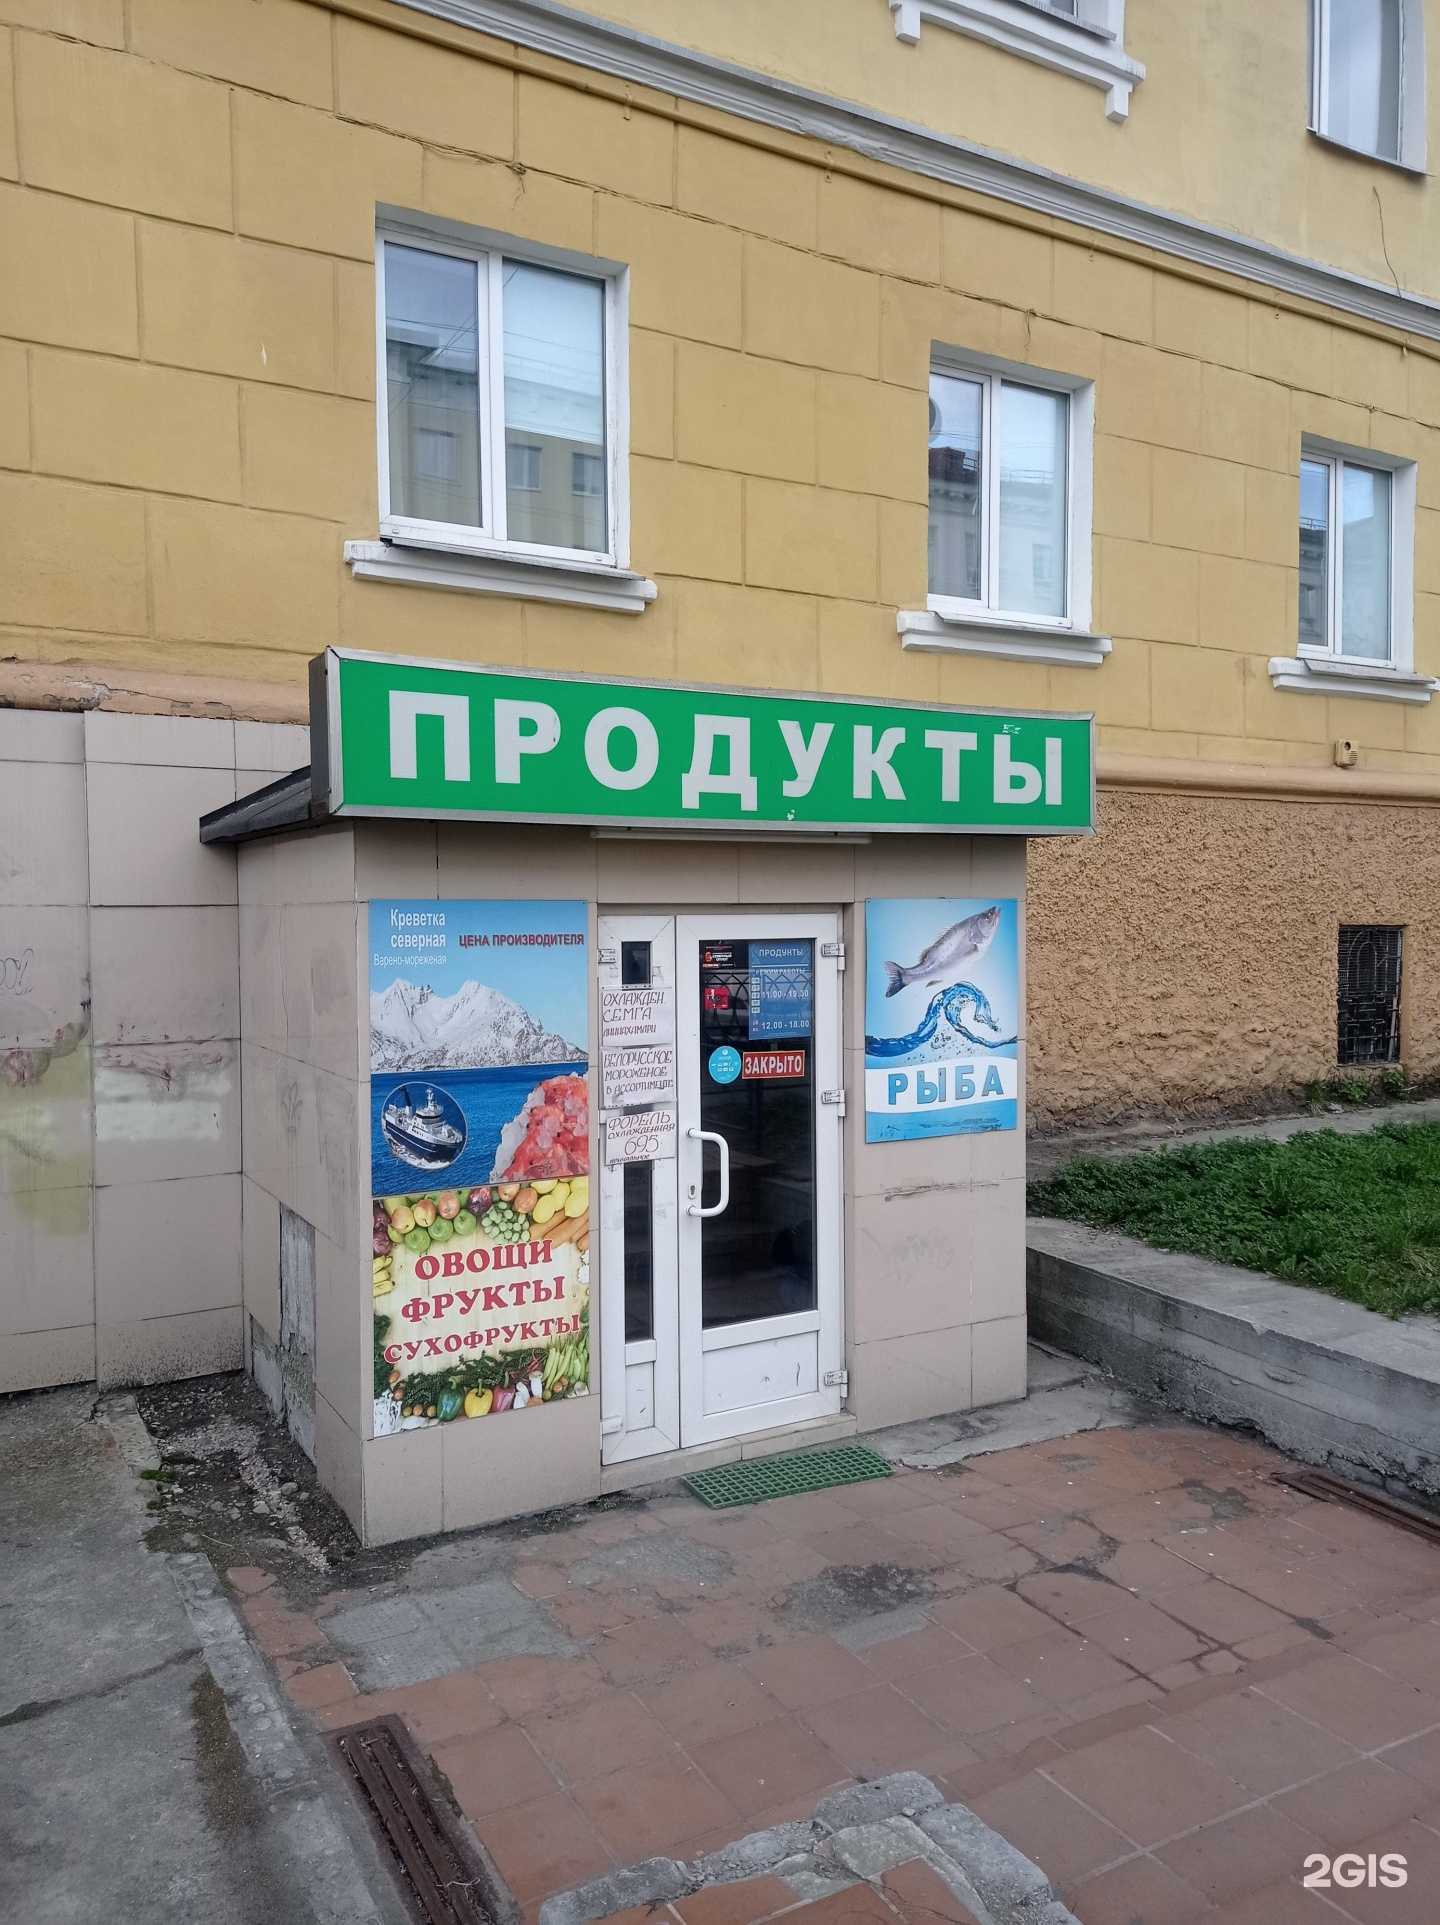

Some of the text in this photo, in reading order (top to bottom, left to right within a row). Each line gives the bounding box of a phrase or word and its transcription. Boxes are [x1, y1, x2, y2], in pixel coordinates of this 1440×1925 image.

[388, 690, 1063, 811] ПРОДУКТЫ
[390, 908, 446, 930] Креветка
[390, 934, 446, 951] северная
[459, 933, 585, 948] ЦЕНА ПРОИЗВОДИТЕЛЯ
[759, 948, 803, 959] ПРОДУКТЫ
[603, 1006, 652, 1023] СЕМГА
[744, 1055, 802, 1074] ЗАКРЫТО
[887, 1064, 1005, 1106] РЫБА
[608, 1111, 671, 1131] ФОРЕЛЬ
[625, 1134, 659, 1156] 695
[414, 1239, 553, 1281] ОВОЩИ
[400, 1275, 566, 1324] ФРУКТЫ
[383, 1313, 581, 1364] СУХОФРУКТЫ
